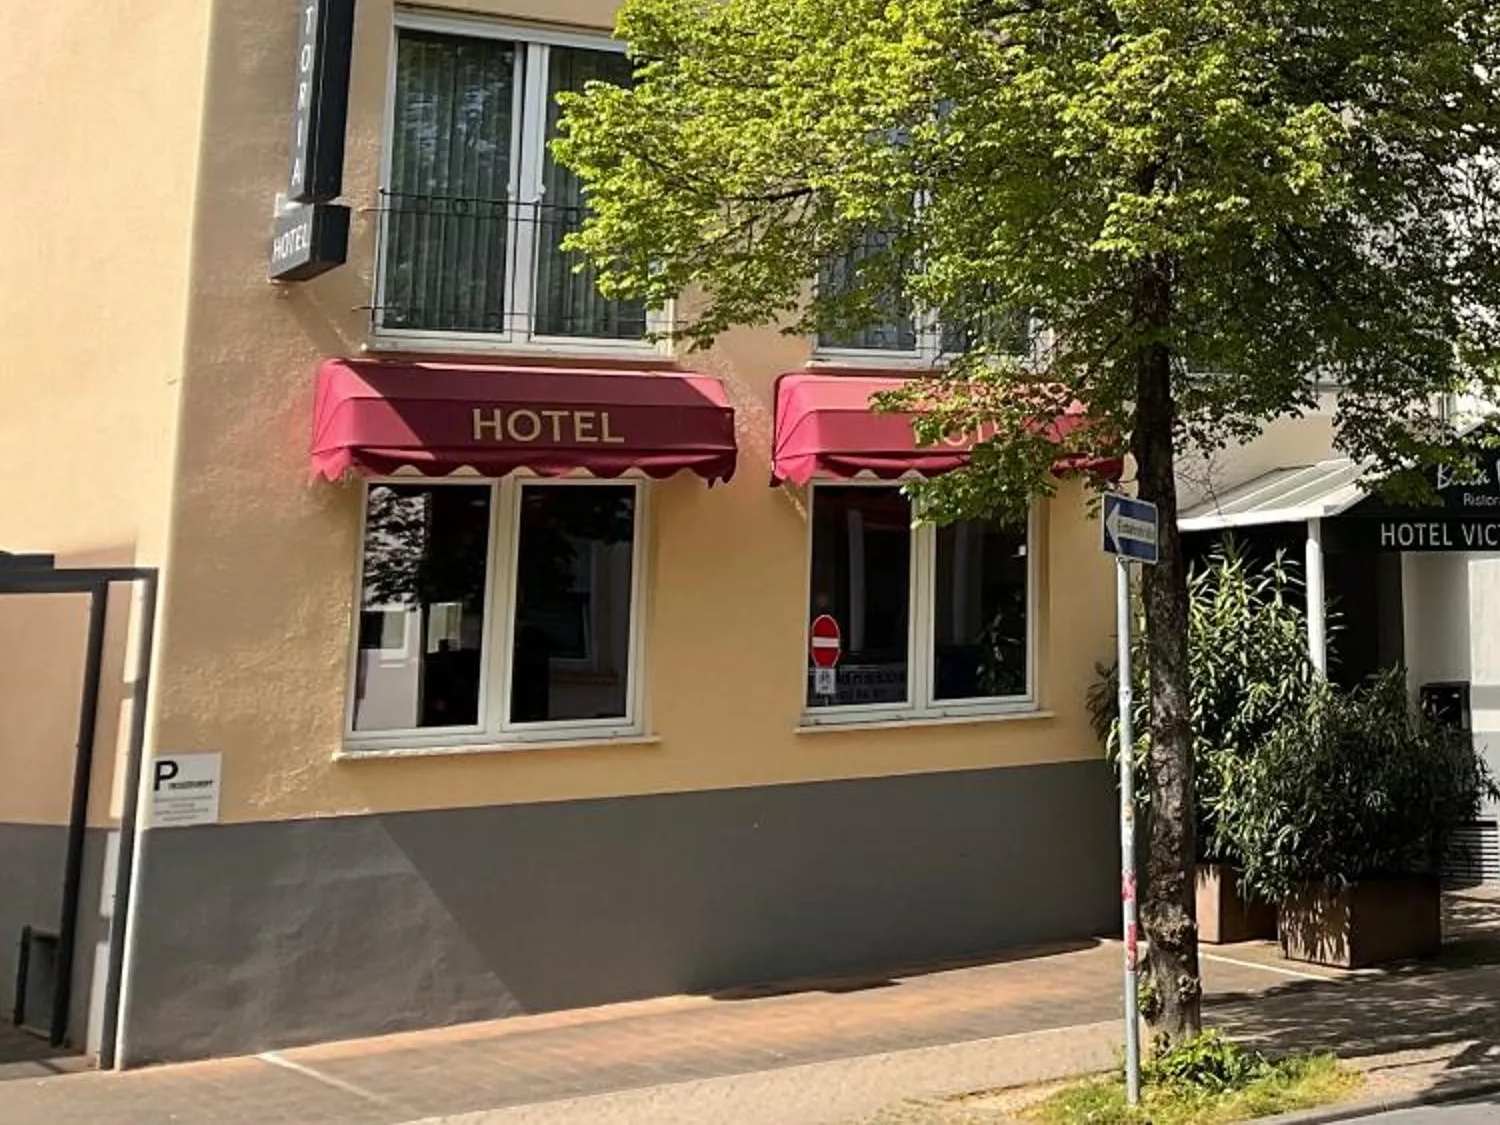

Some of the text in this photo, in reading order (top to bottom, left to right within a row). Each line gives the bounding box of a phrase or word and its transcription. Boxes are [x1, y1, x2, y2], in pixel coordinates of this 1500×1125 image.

[272, 223, 308, 263] HOTEL
[472, 408, 625, 443] HOTEL
[1381, 523, 1453, 546] HOTEL
